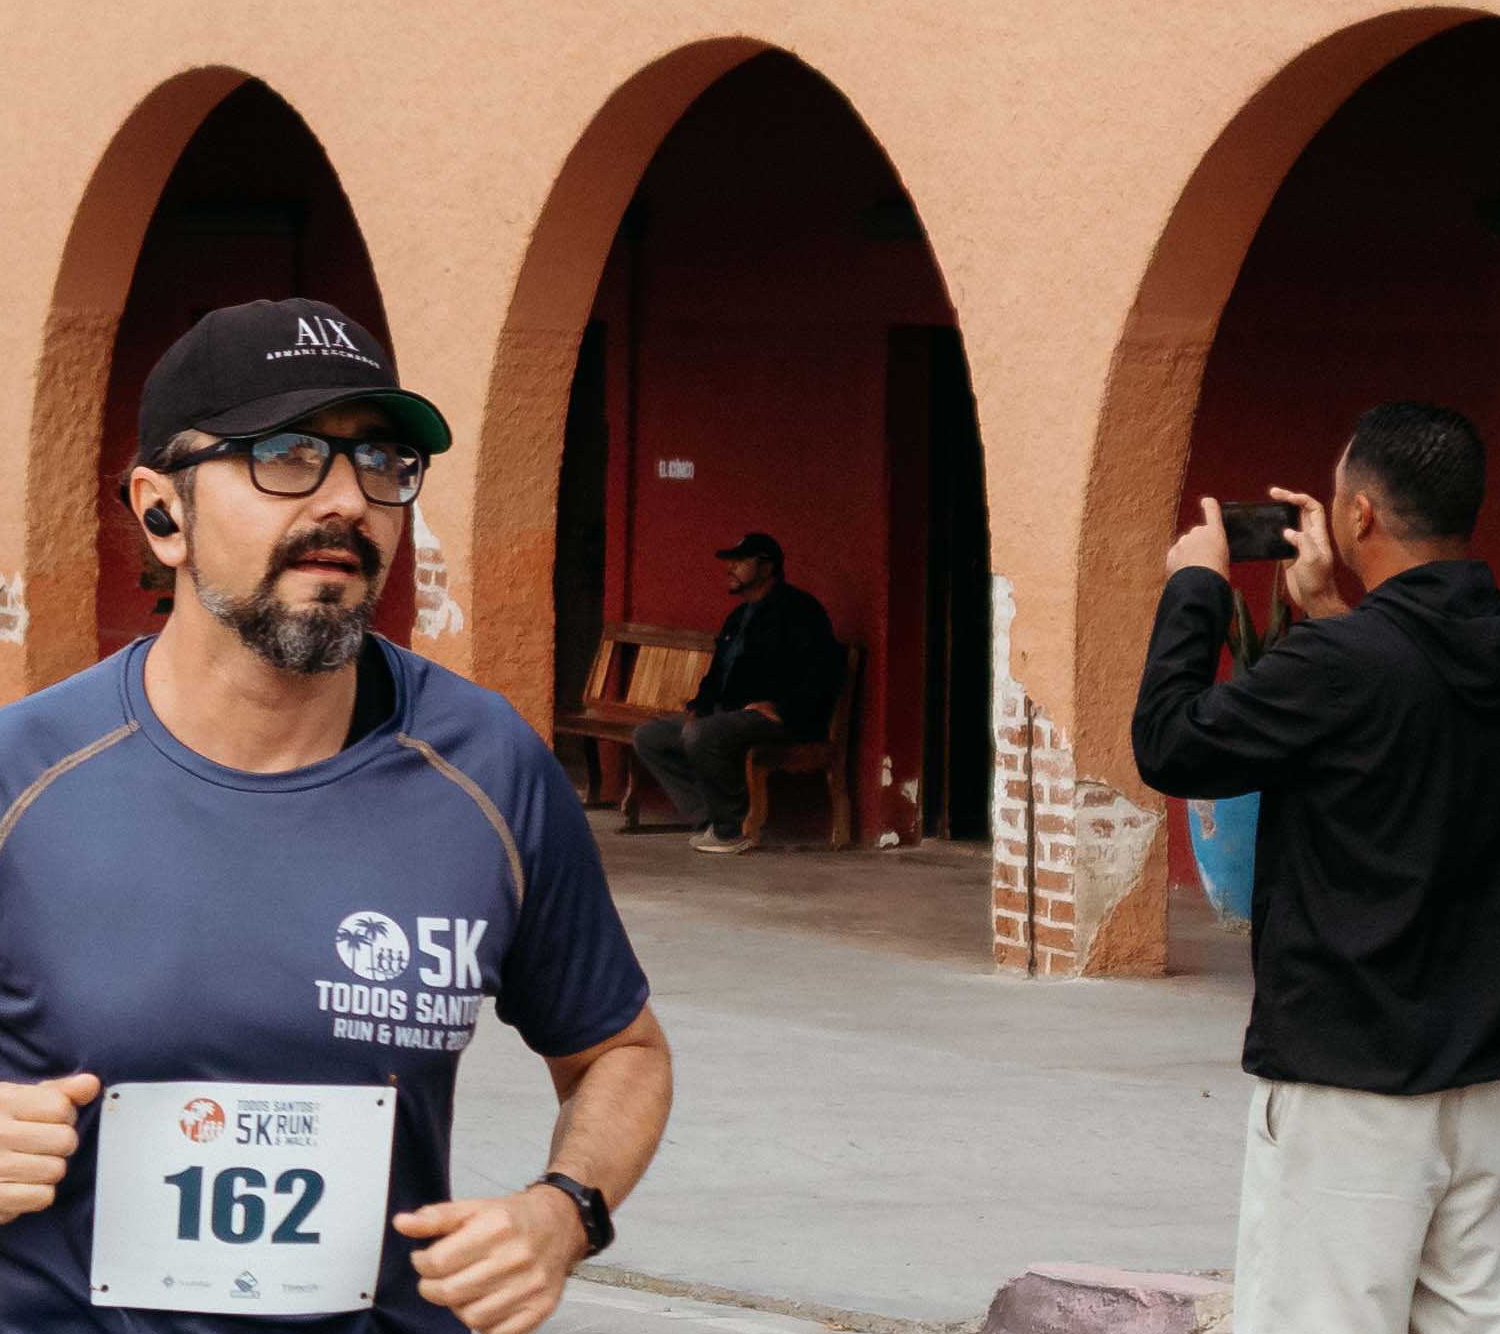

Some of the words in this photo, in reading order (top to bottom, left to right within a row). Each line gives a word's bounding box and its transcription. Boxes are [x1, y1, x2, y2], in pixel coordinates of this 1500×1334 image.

[266, 348, 317, 360] ARMANI
[416, 916, 488, 990] 5K
[314, 980, 408, 1021] TODOS
[333, 1017, 374, 1043] RUN
[377, 1023, 393, 1046] &
[395, 1025, 445, 1050] WALK
[235, 1113, 273, 1146] 5K
[275, 1114, 314, 1135] RUN
[163, 1165, 325, 1244] 162
